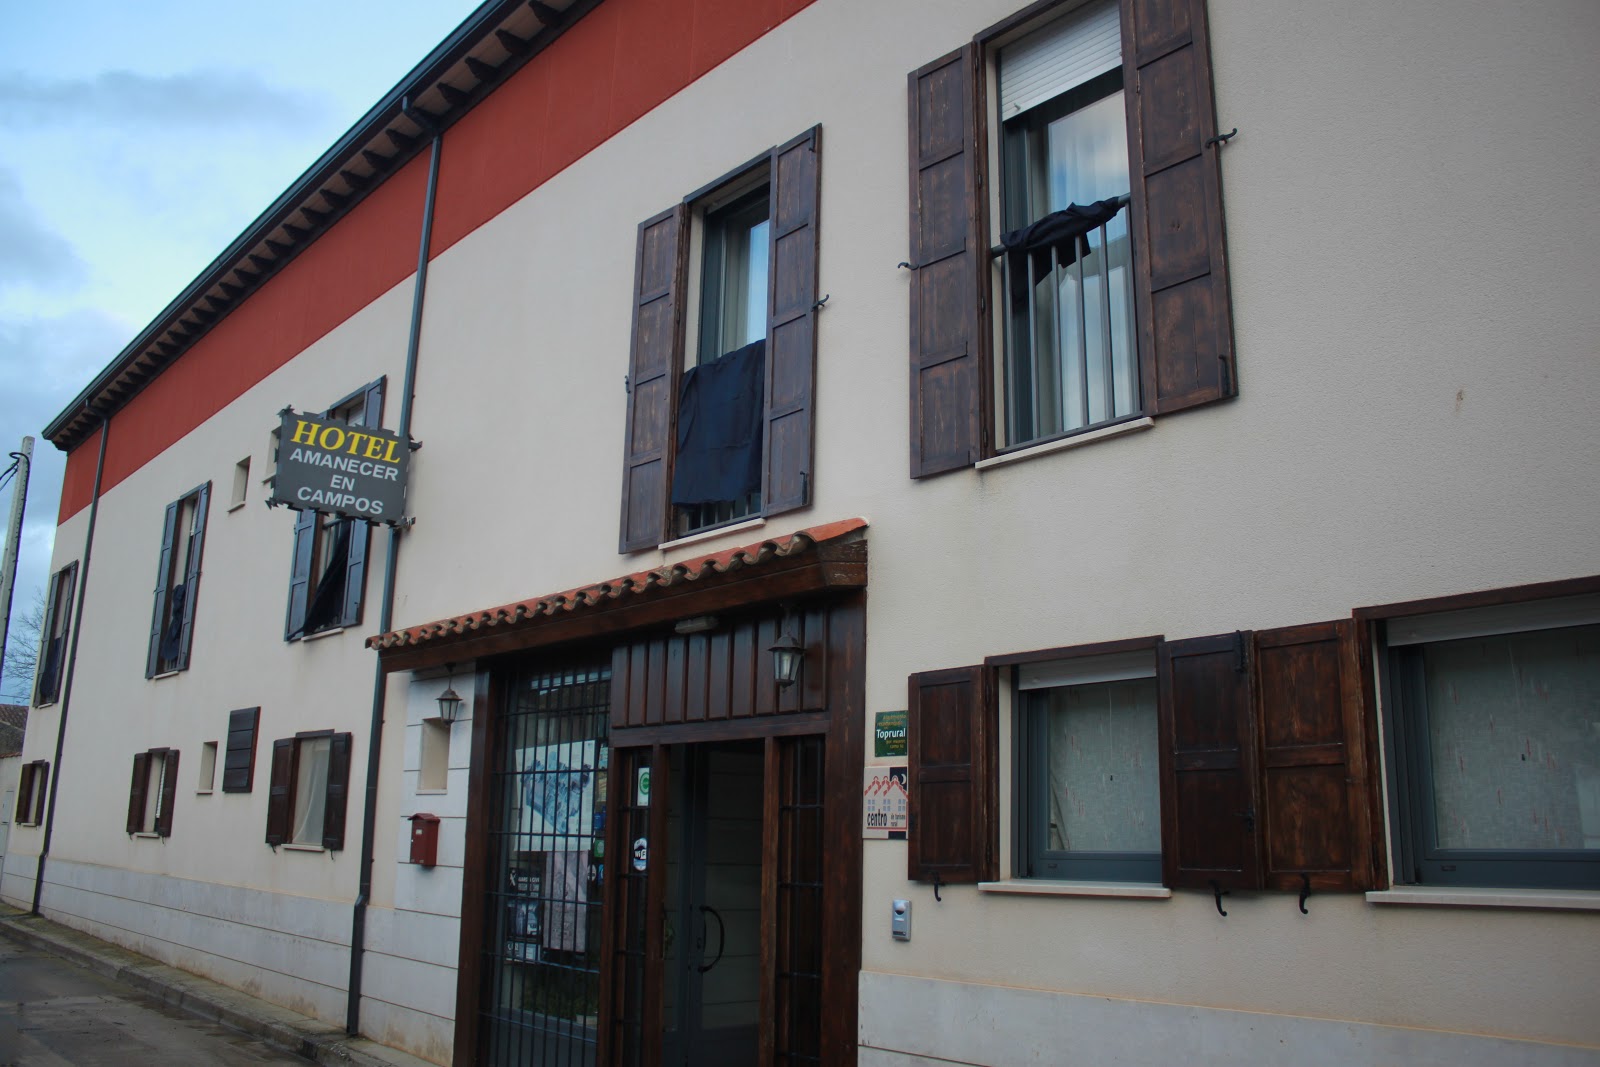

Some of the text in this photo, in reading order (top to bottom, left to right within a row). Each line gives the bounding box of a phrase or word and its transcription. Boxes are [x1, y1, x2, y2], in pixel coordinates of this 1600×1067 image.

[290, 419, 401, 464] HOTEL
[289, 448, 399, 481] AMANECER
[330, 474, 355, 491] EN
[297, 486, 384, 515] CAMPOS
[876, 727, 906, 741] Toprural
[867, 809, 888, 827] centro
